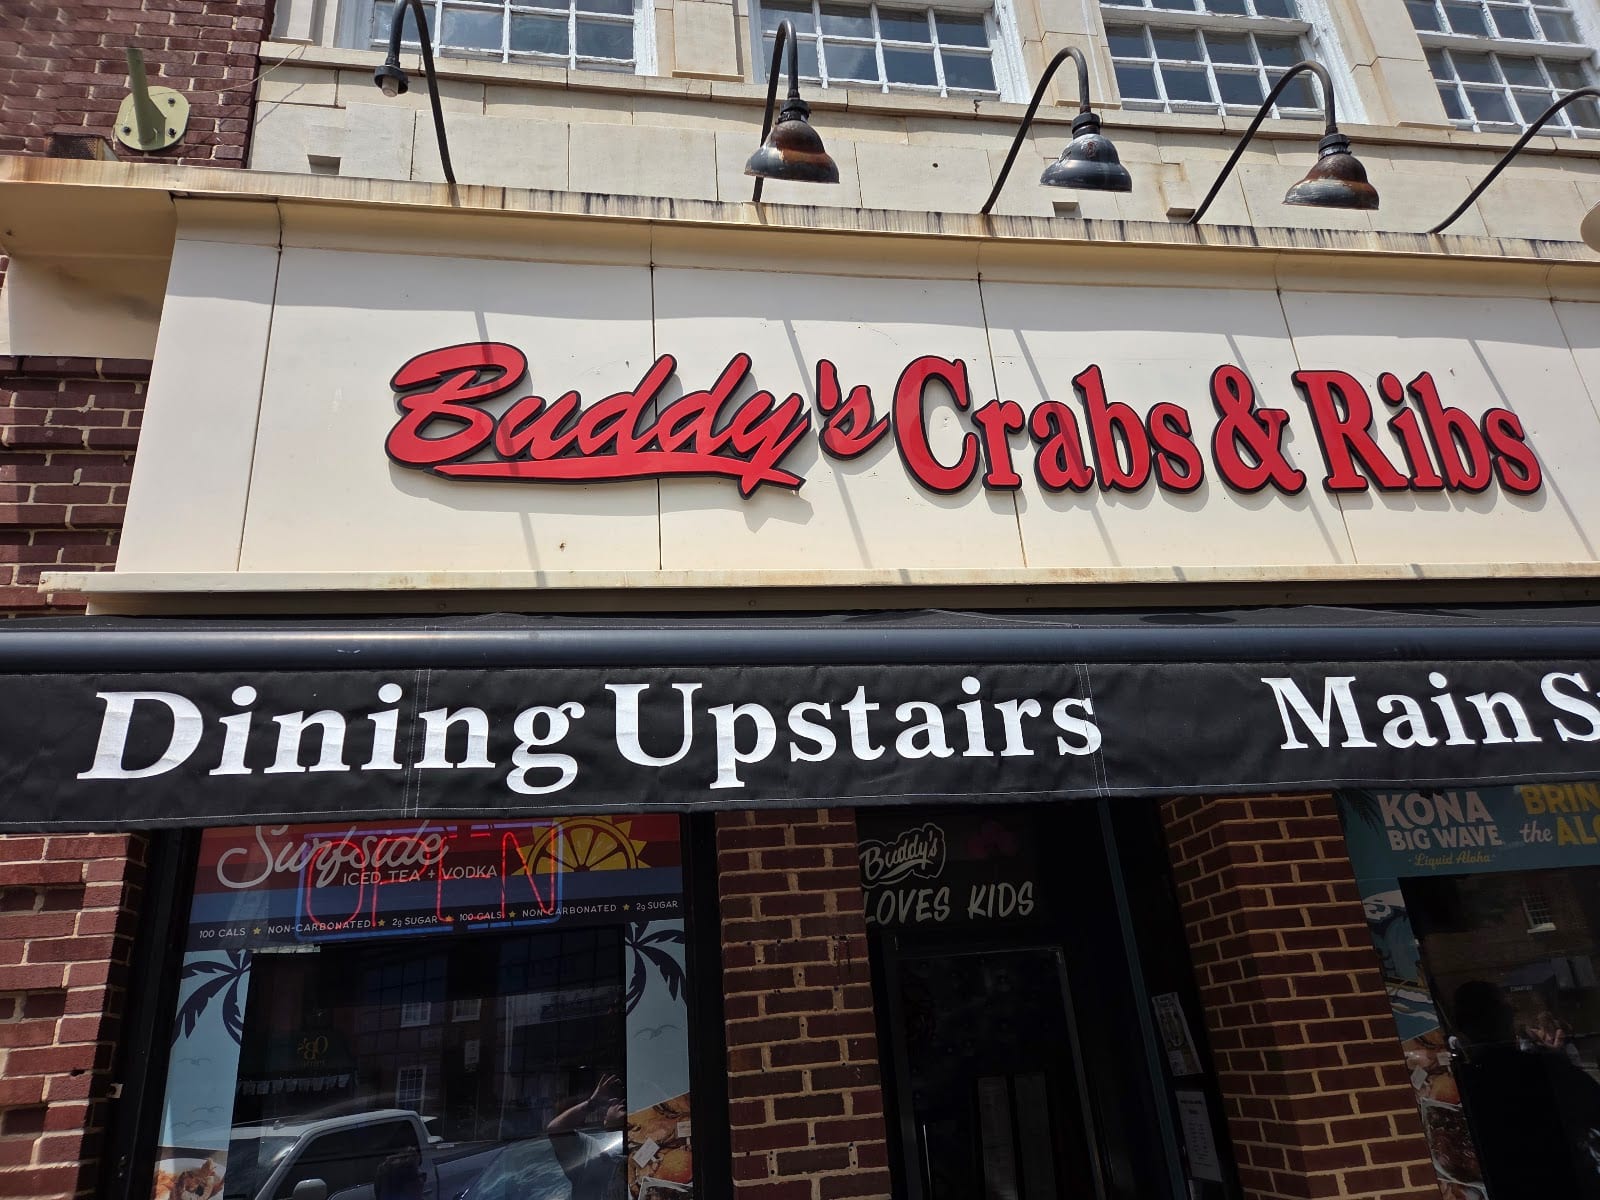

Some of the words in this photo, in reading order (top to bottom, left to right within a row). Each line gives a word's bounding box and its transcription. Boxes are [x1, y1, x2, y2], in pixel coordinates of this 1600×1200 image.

[385, 342, 891, 500] Buddy's
[891, 354, 1205, 495] Crabs
[1210, 364, 1306, 494] &
[1293, 369, 1545, 495] Ribs
[1260, 671, 1542, 750] Main
[1540, 672, 1600, 742] S
[77, 683, 585, 795] Dining
[605, 676, 1102, 790] Upstairs
[1376, 790, 1495, 829] KONA
[1387, 828, 1431, 851] BIG
[1433, 825, 1504, 848] WAVE
[1520, 820, 1552, 844] the
[217, 819, 449, 888] Surfside
[859, 830, 938, 880] Buddy's
[1414, 852, 1453, 870] Liquid
[1456, 851, 1491, 864] Aloha
[306, 831, 556, 930] OPEN
[343, 871, 382, 886] ICED
[388, 869, 421, 883] TEA
[441, 865, 498, 880] VODKA
[200, 929, 214, 939] 100
[218, 927, 246, 938] CALS
[267, 919, 371, 935] NON-CARBONATED
[392, 918, 402, 928] 2g
[404, 915, 438, 926] SUGAR
[459, 912, 474, 922] 100
[476, 911, 502, 921] CALS
[636, 902, 646, 912] 2g
[648, 900, 679, 911] SUGAR
[967, 881, 1035, 919] KIDS
